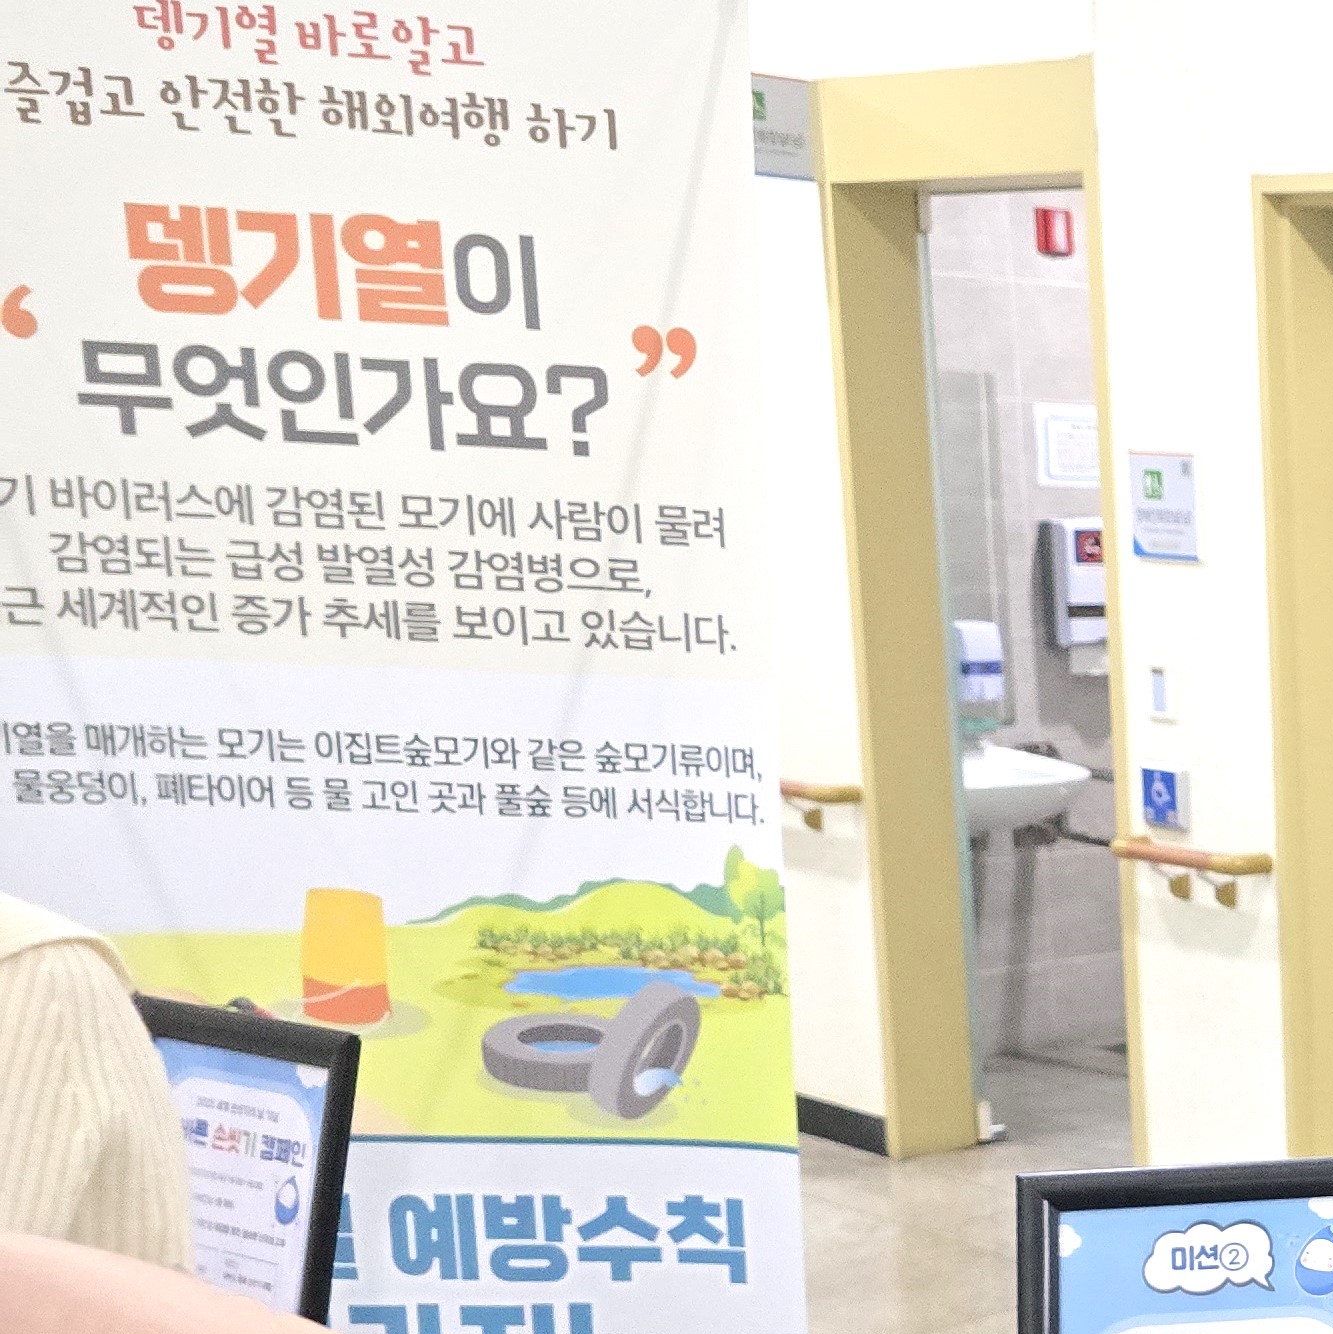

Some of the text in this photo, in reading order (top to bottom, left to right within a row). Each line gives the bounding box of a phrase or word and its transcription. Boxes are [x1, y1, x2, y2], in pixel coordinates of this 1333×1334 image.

[134, 0, 278, 65] 뎅기열
[3, 60, 620, 151] 즐겁고 안전한 해외여행 하기
[123, 201, 541, 330] 뎅기열이
[77, 339, 609, 458] 무엇인가요?
[49, 476, 255, 527] 바이러스에
[266, 484, 387, 533] 감염된
[398, 494, 517, 540] 모기에
[528, 501, 644, 546] 사람이
[653, 503, 727, 550] 물려
[48, 531, 653, 600] 감염되는 급성 발열성 감염병으로,
[2, 586, 739, 656] 근 세계적인 증가 추세를 보이고 있습니다.
[84, 722, 208, 761] 매개하는
[217, 727, 306, 765] 모기는
[314, 730, 520, 772] 이집트숲모기와
[527, 737, 586, 772] 같은
[156, 772, 275, 811] 폐타이어
[284, 775, 313, 809] 등
[322, 776, 352, 812] 물
[361, 778, 419, 815] 고인
[428, 781, 486, 818] 곳과
[495, 782, 552, 819] 풀숲
[561, 785, 618, 821] 등에
[626, 785, 766, 827] 서식합니다.
[388, 1193, 749, 1285] 예방수칙
